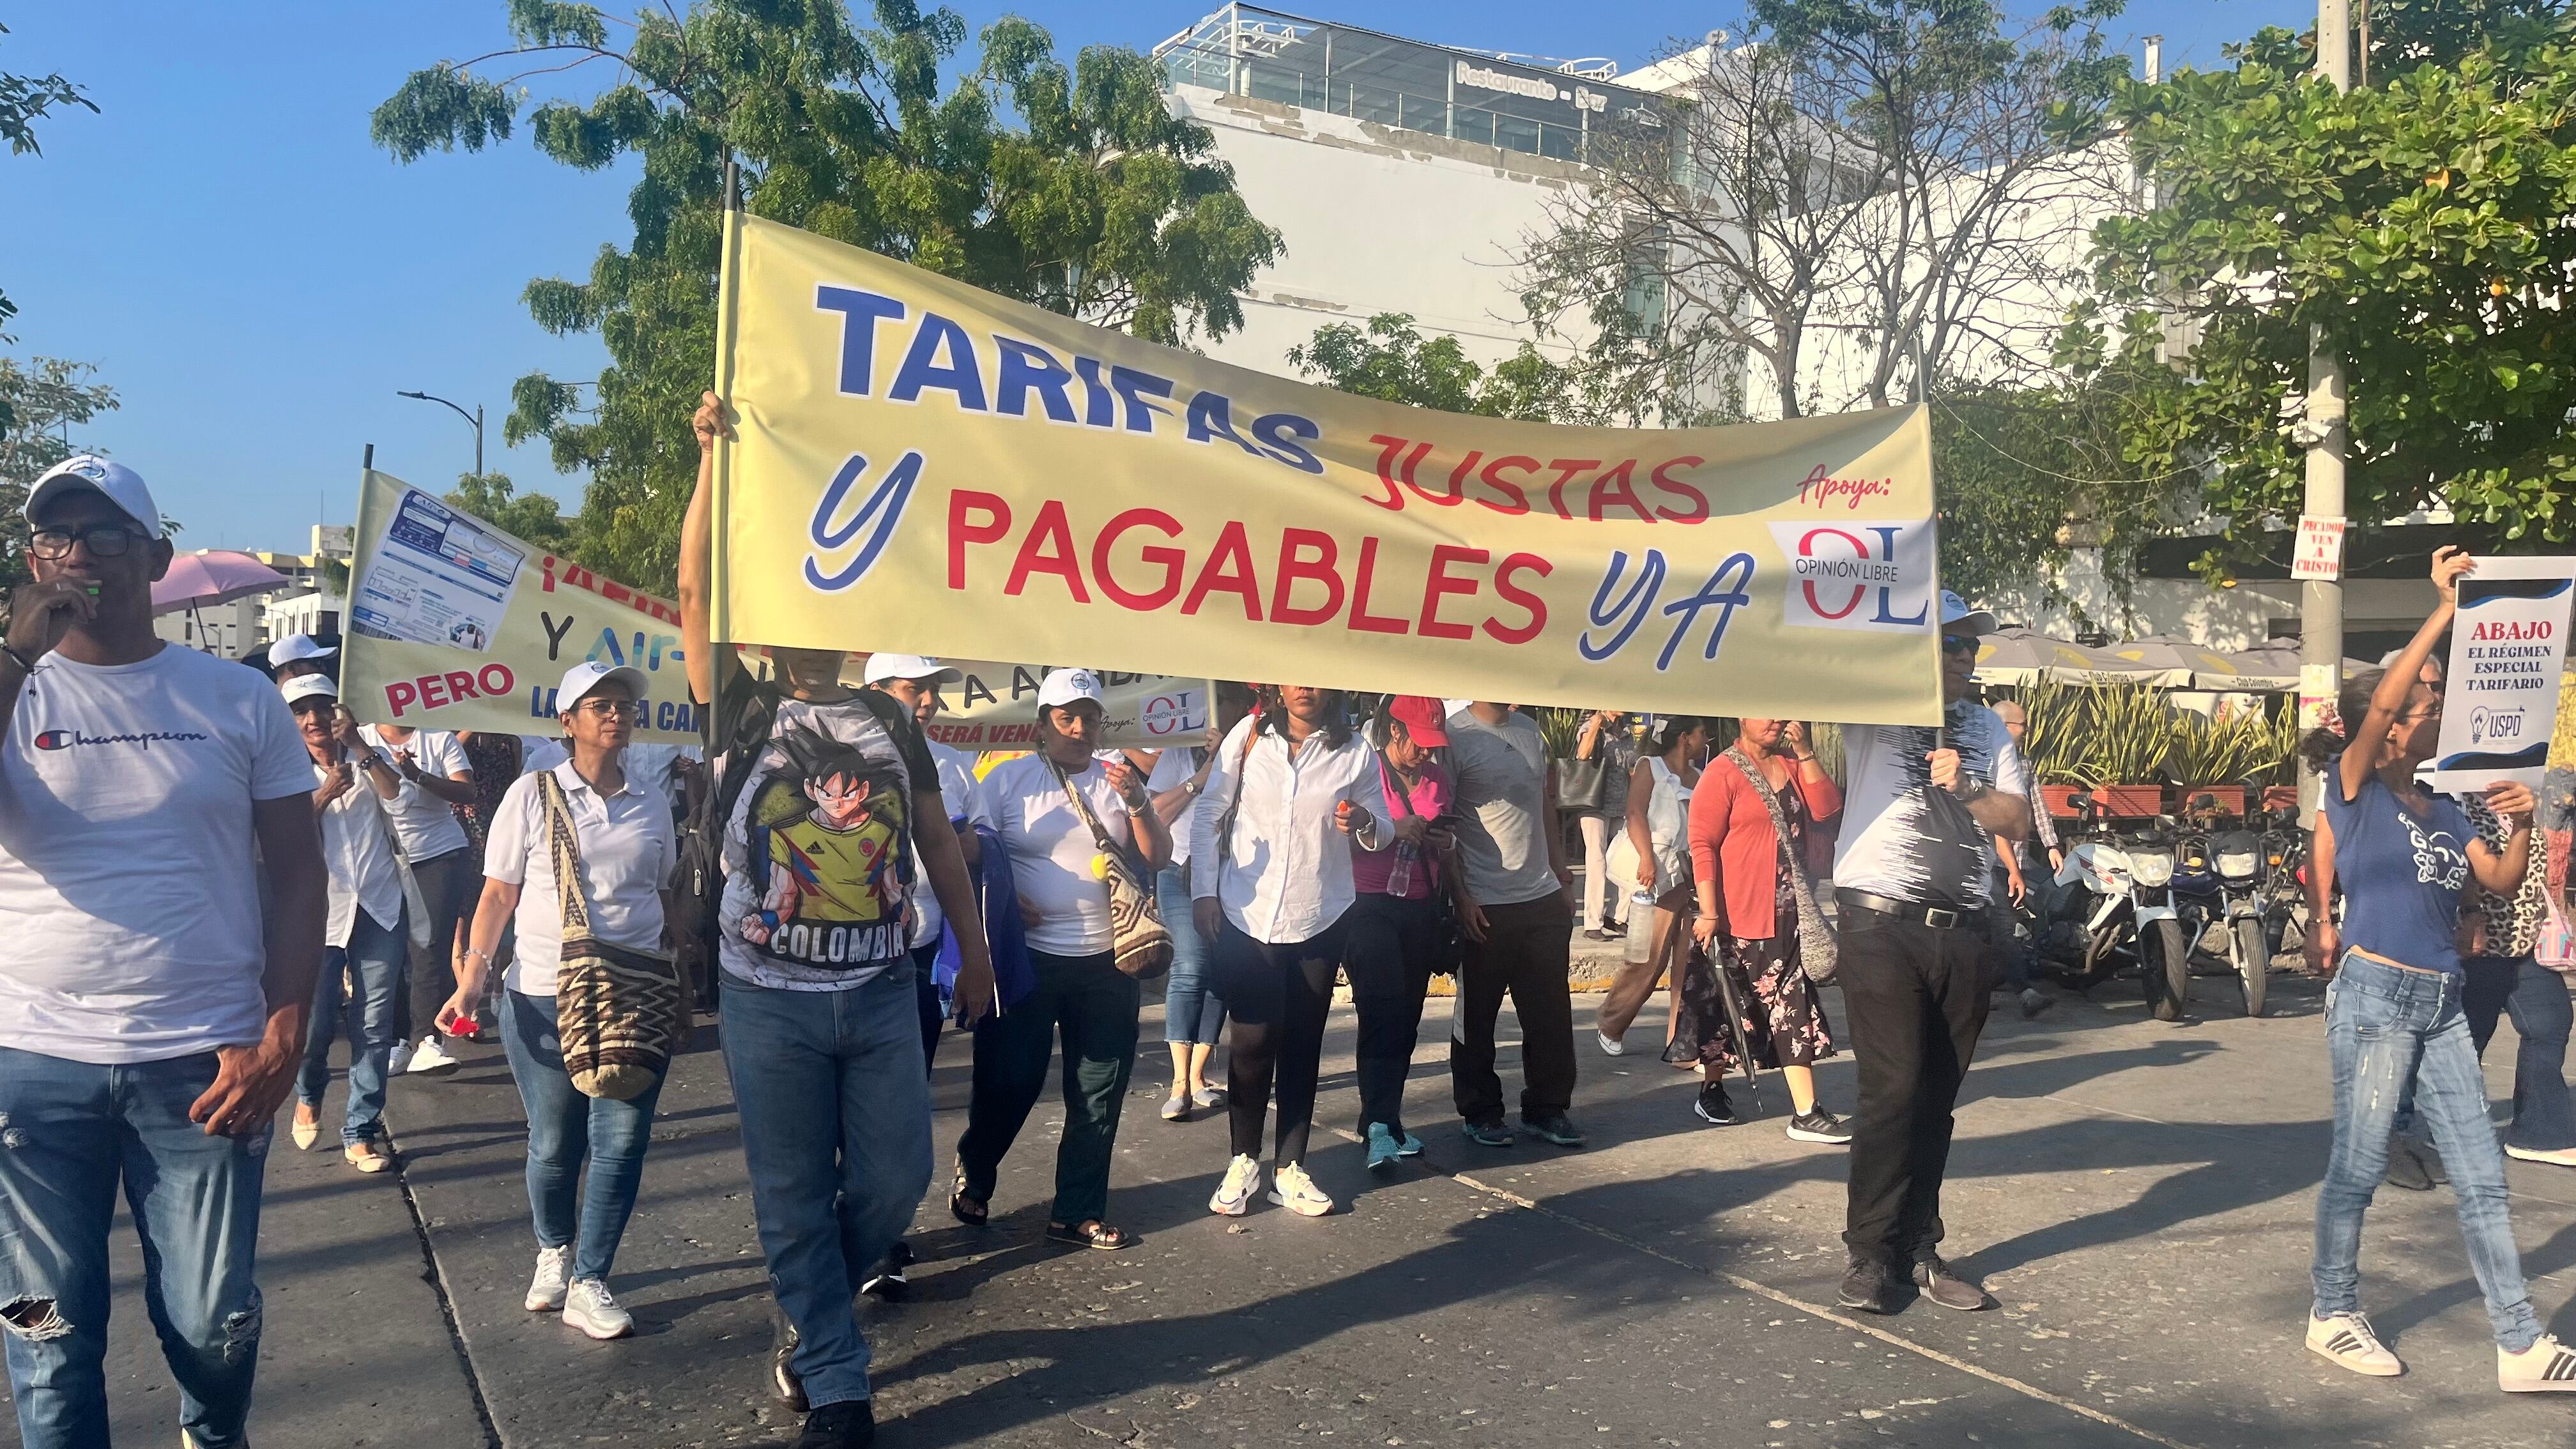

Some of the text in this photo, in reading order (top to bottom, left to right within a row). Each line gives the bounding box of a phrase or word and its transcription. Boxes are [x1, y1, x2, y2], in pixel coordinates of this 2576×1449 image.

[1457, 61, 1556, 100] Restaurante
[816, 286, 1710, 524] TARIFAS JUSTAS
[1796, 463, 1891, 509] Apoya:
[2303, 521, 2344, 533] PECADOR
[2312, 535, 2334, 545] VEN
[2312, 547, 2324, 558] A
[948, 489, 1553, 645] PAGABLES
[1795, 558, 1898, 582] OPINIÓN LIBRE
[2296, 560, 2338, 573] CRISTO
[541, 611, 574, 661] Y
[2471, 620, 2552, 640] ABAJO
[2467, 642, 2552, 658] EL RÉGIMEN
[2474, 662, 2543, 673] ESPECIAL
[385, 663, 515, 717] PERO
[2466, 677, 2544, 691] TARIFARIO
[1142, 707, 1190, 723] OPINIÓN LIBRE
[926, 722, 986, 743] SERÁ
[2489, 715, 2521, 737] USPD
[34, 729, 208, 751] Champion
[770, 921, 905, 963] COLOMBIA
